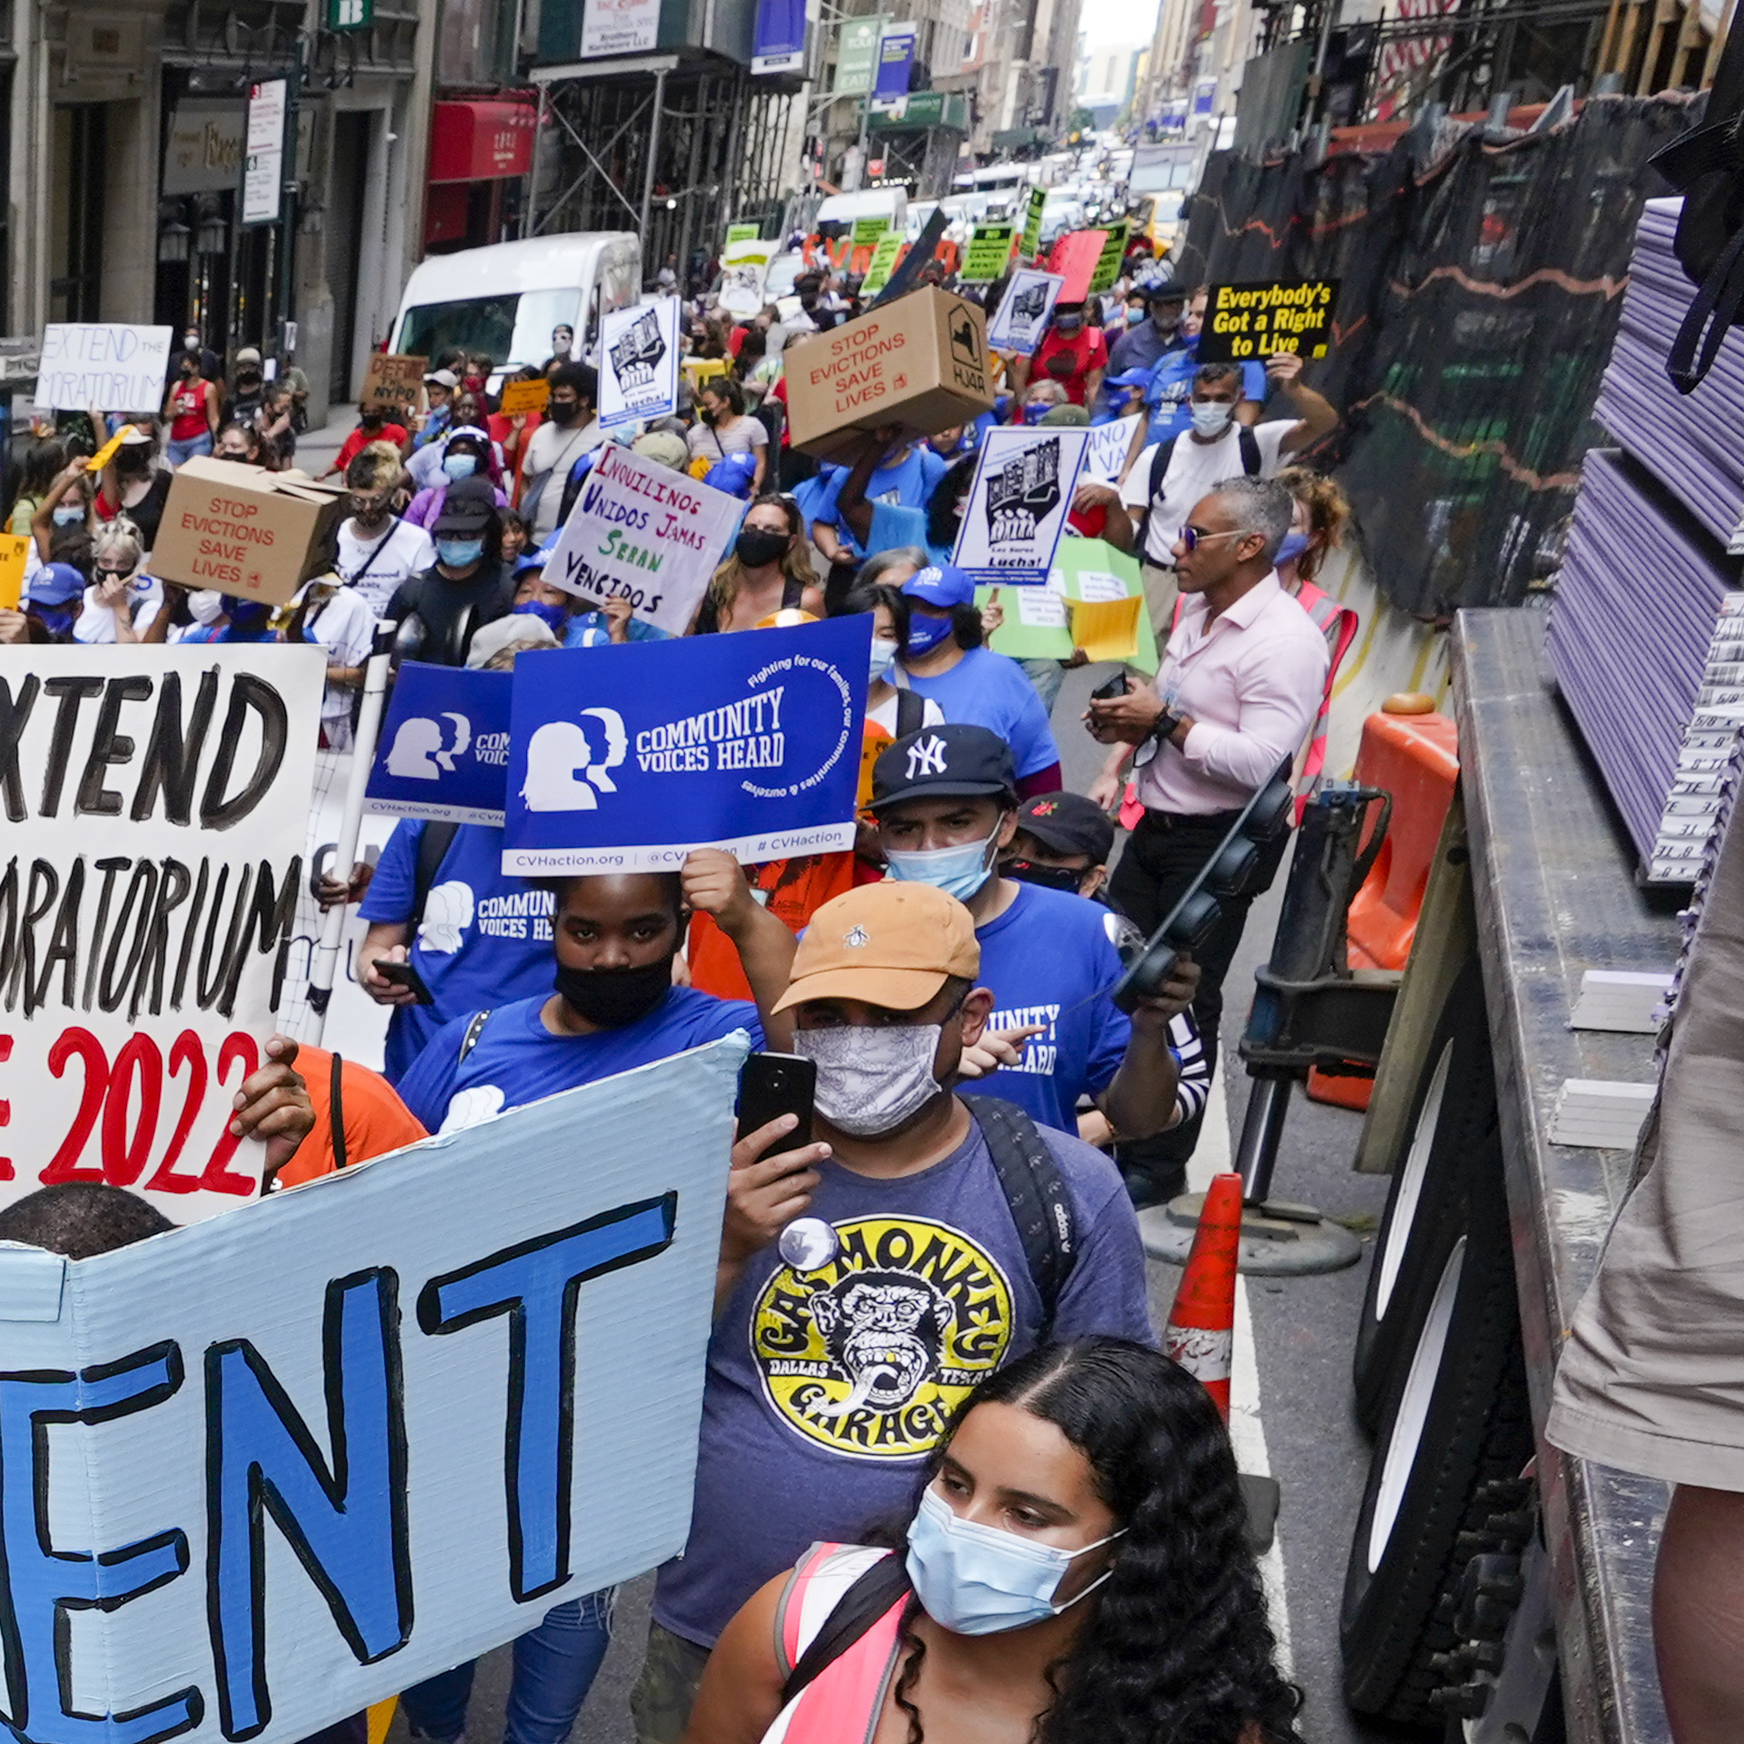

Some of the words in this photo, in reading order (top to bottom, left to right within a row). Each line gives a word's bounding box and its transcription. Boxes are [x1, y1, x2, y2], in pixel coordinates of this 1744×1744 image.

[1216, 282, 1331, 311] Everybody's
[1213, 311, 1251, 334] Got
[1254, 314, 1269, 332] a
[1273, 307, 1326, 334] Right
[44, 327, 138, 363] EXTEND
[142, 340, 164, 354] THE
[831, 323, 879, 357] STOP
[1231, 336, 1253, 357] to
[1258, 332, 1300, 356] Live
[810, 333, 905, 386] EVICTIONS
[39, 372, 163, 410] MORATORIUM
[835, 362, 883, 394] SAVE
[836, 382, 886, 414] LIVES
[595, 446, 702, 516] INQUILINOS
[208, 498, 258, 519] STOP
[582, 483, 650, 531] UNIDOS
[656, 513, 706, 551] JAMAS
[181, 513, 275, 546] EVICTIONS
[198, 539, 248, 564] SAVE
[598, 529, 664, 573] SERAN
[192, 558, 241, 583] LIVES
[747, 657, 793, 689] Fighting
[794, 654, 811, 667] for
[811, 658, 830, 672] our
[636, 686, 785, 754] COMMUNITY
[843, 707, 853, 729] our
[636, 746, 710, 774] VOICES
[716, 731, 786, 771] HEARD
[799, 729, 850, 791] communities
[904, 734, 949, 781] NY
[516, 852, 625, 869] CVHaction.org
[771, 830, 843, 851] CVHaction
[477, 918, 529, 941] VOICES
[38, 1027, 263, 1197] 2022
[1054, 1202, 1069, 1240] adidas
[833, 1227, 1003, 1364] MONKEY
[769, 1359, 829, 1379] DALLAS
